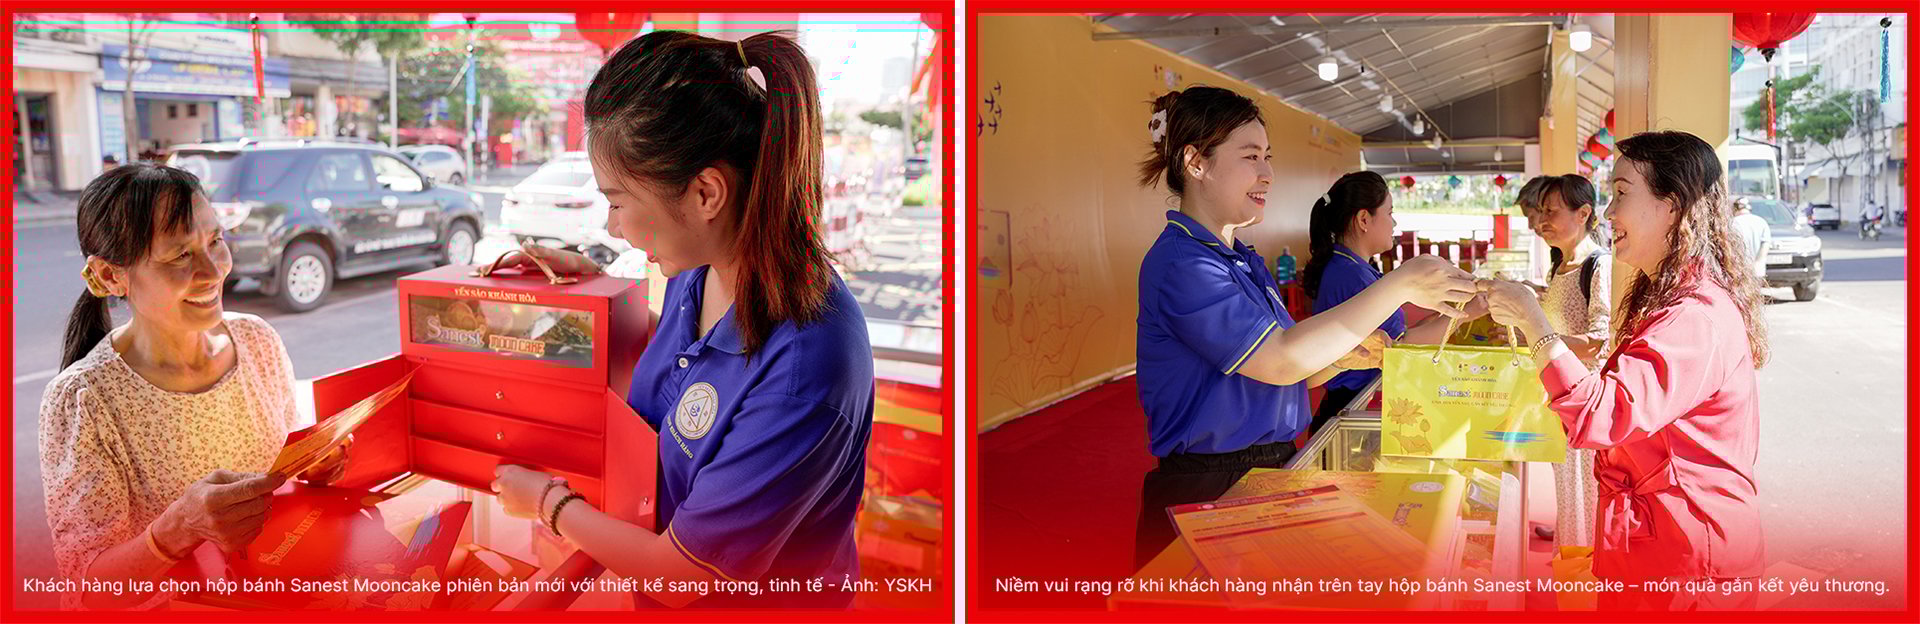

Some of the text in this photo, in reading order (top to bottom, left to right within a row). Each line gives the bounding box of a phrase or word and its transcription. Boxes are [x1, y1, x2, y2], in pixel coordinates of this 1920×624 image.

[470, 287, 487, 298] SÀO
[487, 290, 518, 302] KHÁNH
[518, 291, 537, 304] HÒA
[426, 314, 485, 347] Sanest
